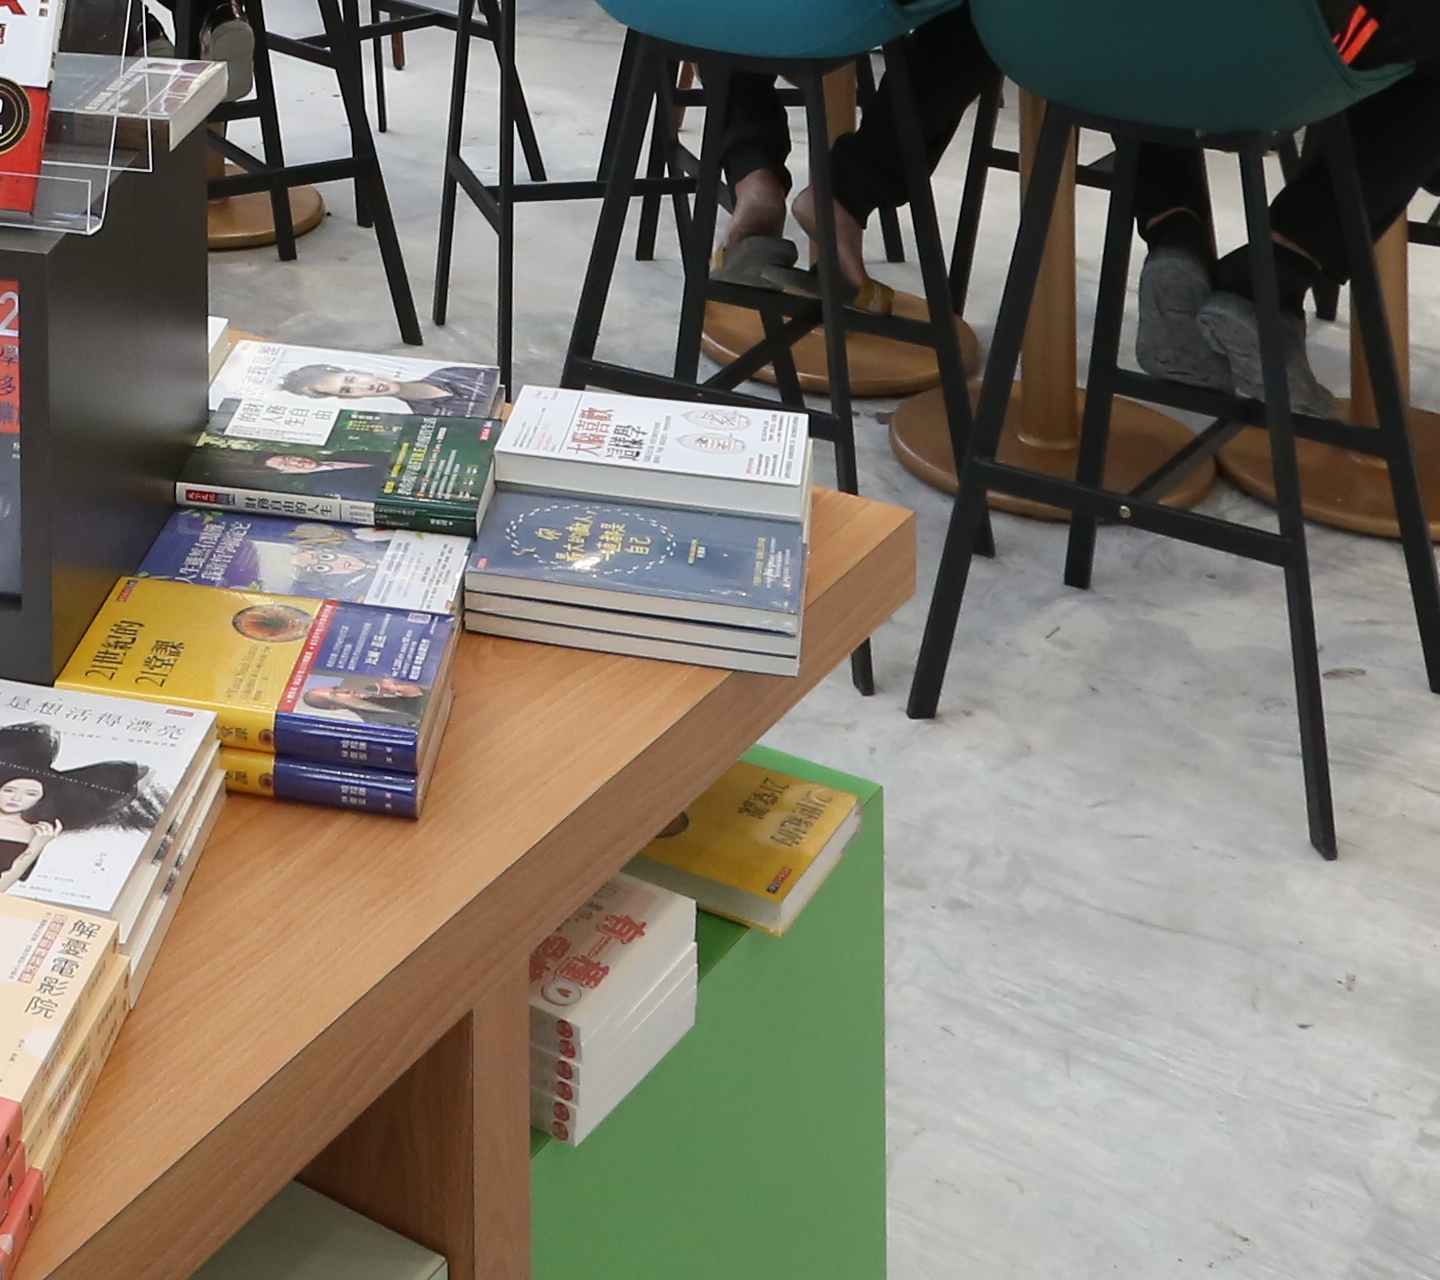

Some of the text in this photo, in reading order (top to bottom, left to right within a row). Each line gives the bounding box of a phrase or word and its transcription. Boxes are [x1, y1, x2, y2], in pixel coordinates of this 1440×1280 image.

[566, 406, 616, 458] 大腦喜歡
[604, 423, 650, 462] 這樣學
[244, 494, 333, 518] 財務自由的人生
[625, 534, 653, 557] 自己
[84, 618, 146, 681] 21世紀的
[134, 638, 186, 688] 21堂課
[23, 918, 102, 1021] 解憂電影院
